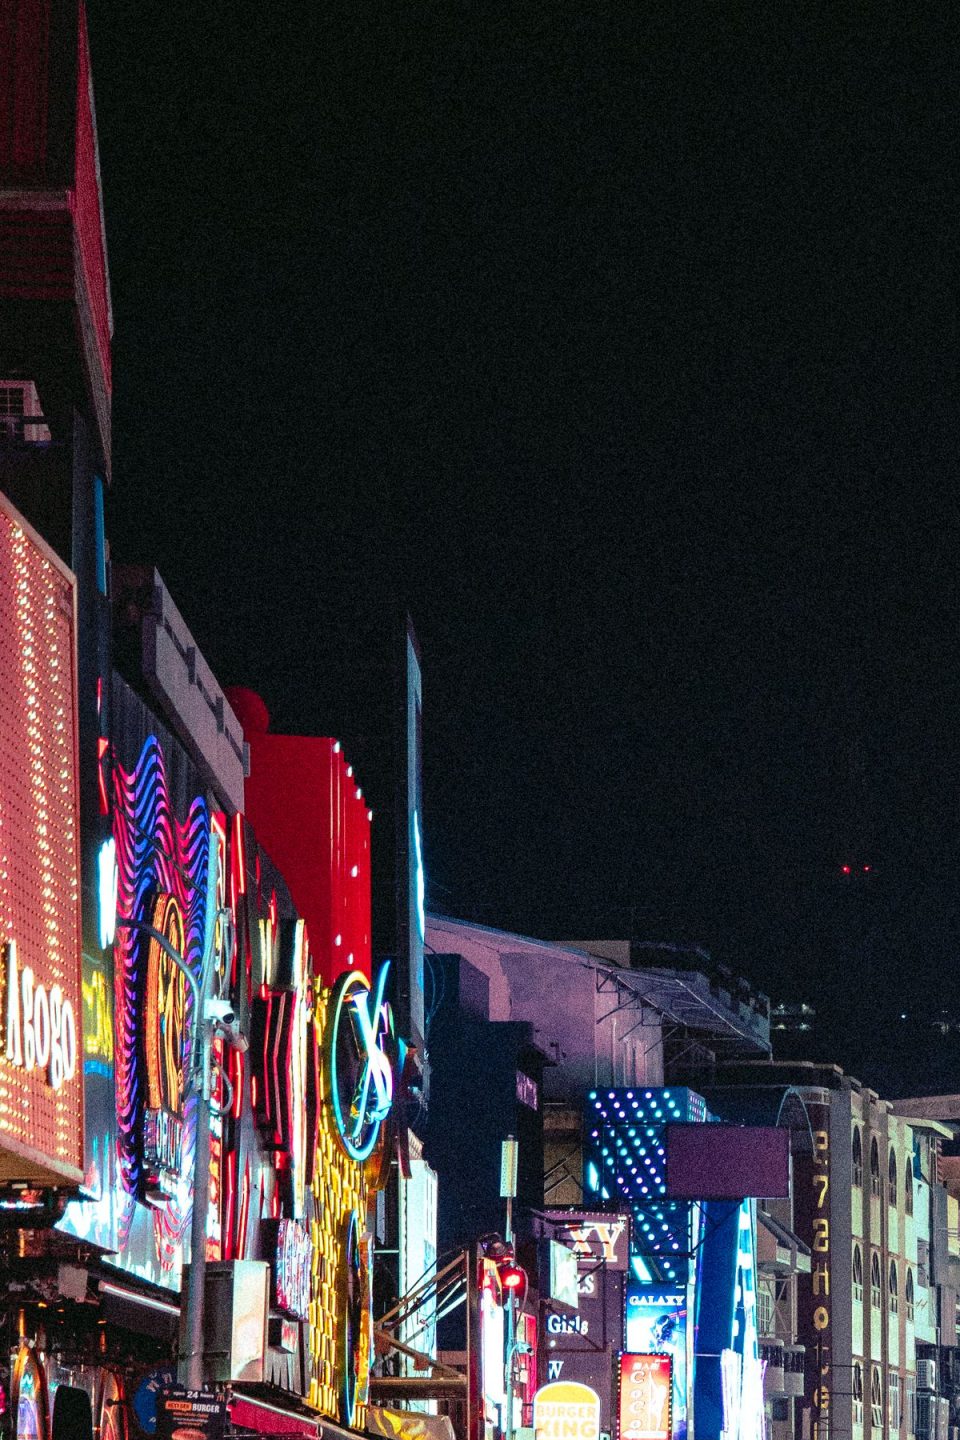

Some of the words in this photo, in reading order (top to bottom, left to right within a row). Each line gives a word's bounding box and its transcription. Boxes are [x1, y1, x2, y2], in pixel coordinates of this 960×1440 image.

[629, 1295, 685, 1306] GALAXY
[547, 1314, 589, 1336] Girls
[187, 1390, 199, 1399] 24
[192, 1403, 220, 1413] BURGER
[537, 1405, 596, 1418] BURGER
[537, 1420, 596, 1439] KING
